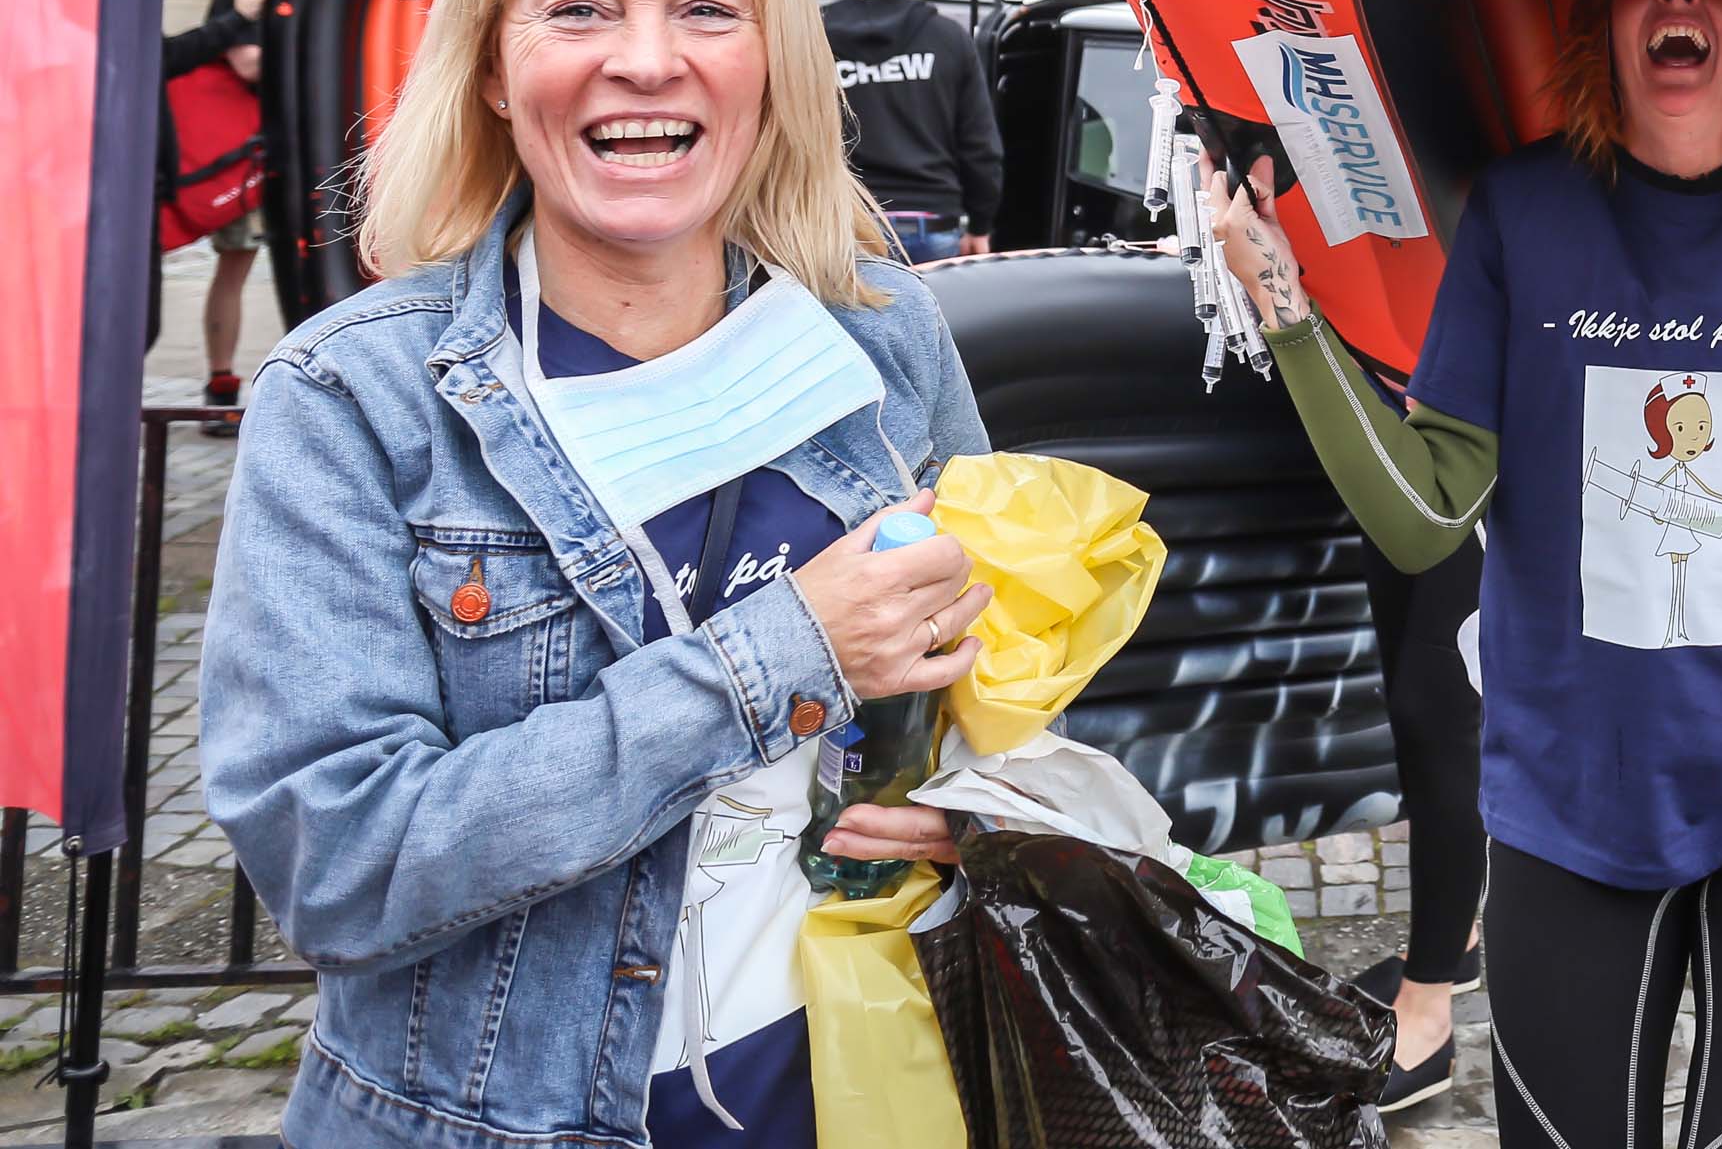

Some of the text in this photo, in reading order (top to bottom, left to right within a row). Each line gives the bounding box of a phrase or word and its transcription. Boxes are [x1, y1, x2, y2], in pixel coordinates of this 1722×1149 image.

[836, 52, 935, 89] CREW
[1568, 310, 1641, 348] Ikkje
[1649, 315, 1704, 342] stol
[724, 542, 792, 598] på
